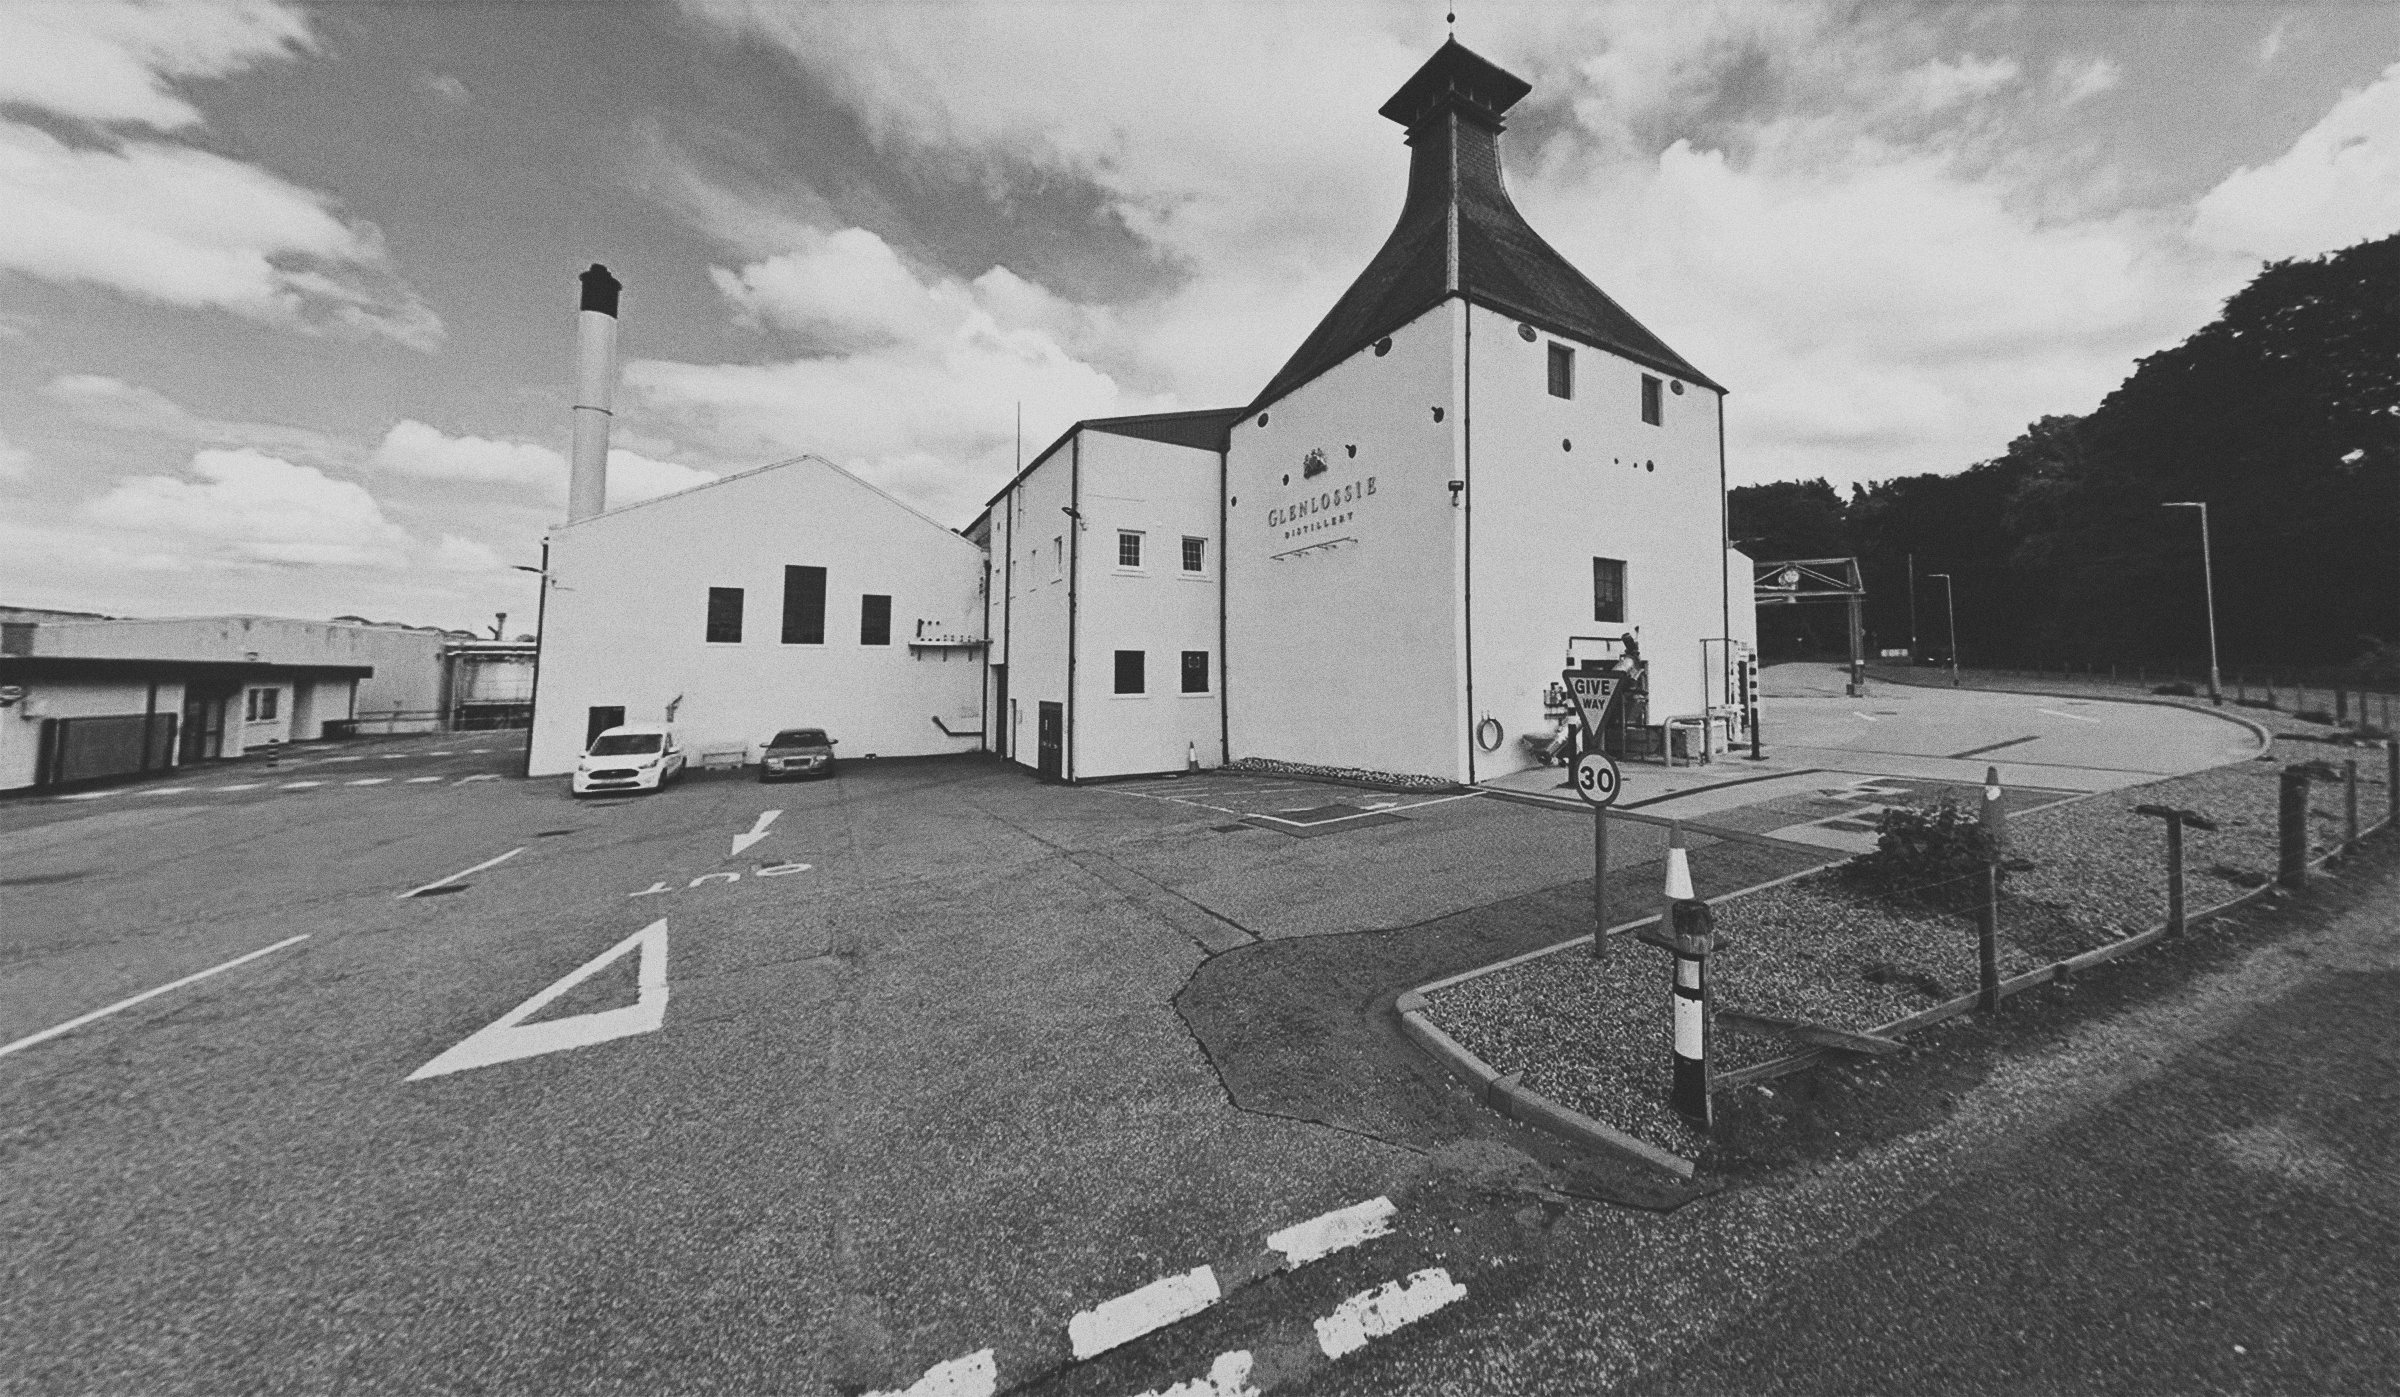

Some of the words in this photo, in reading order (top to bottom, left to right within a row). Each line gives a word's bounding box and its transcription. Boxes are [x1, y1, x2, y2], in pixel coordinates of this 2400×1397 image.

[1268, 476, 1377, 528] GLENLOSSIE
[1285, 511, 1353, 539] DISTILLERY
[1575, 679, 1611, 696] GIVE
[1583, 698, 1606, 711] WAY
[1580, 766, 1614, 793] 30
